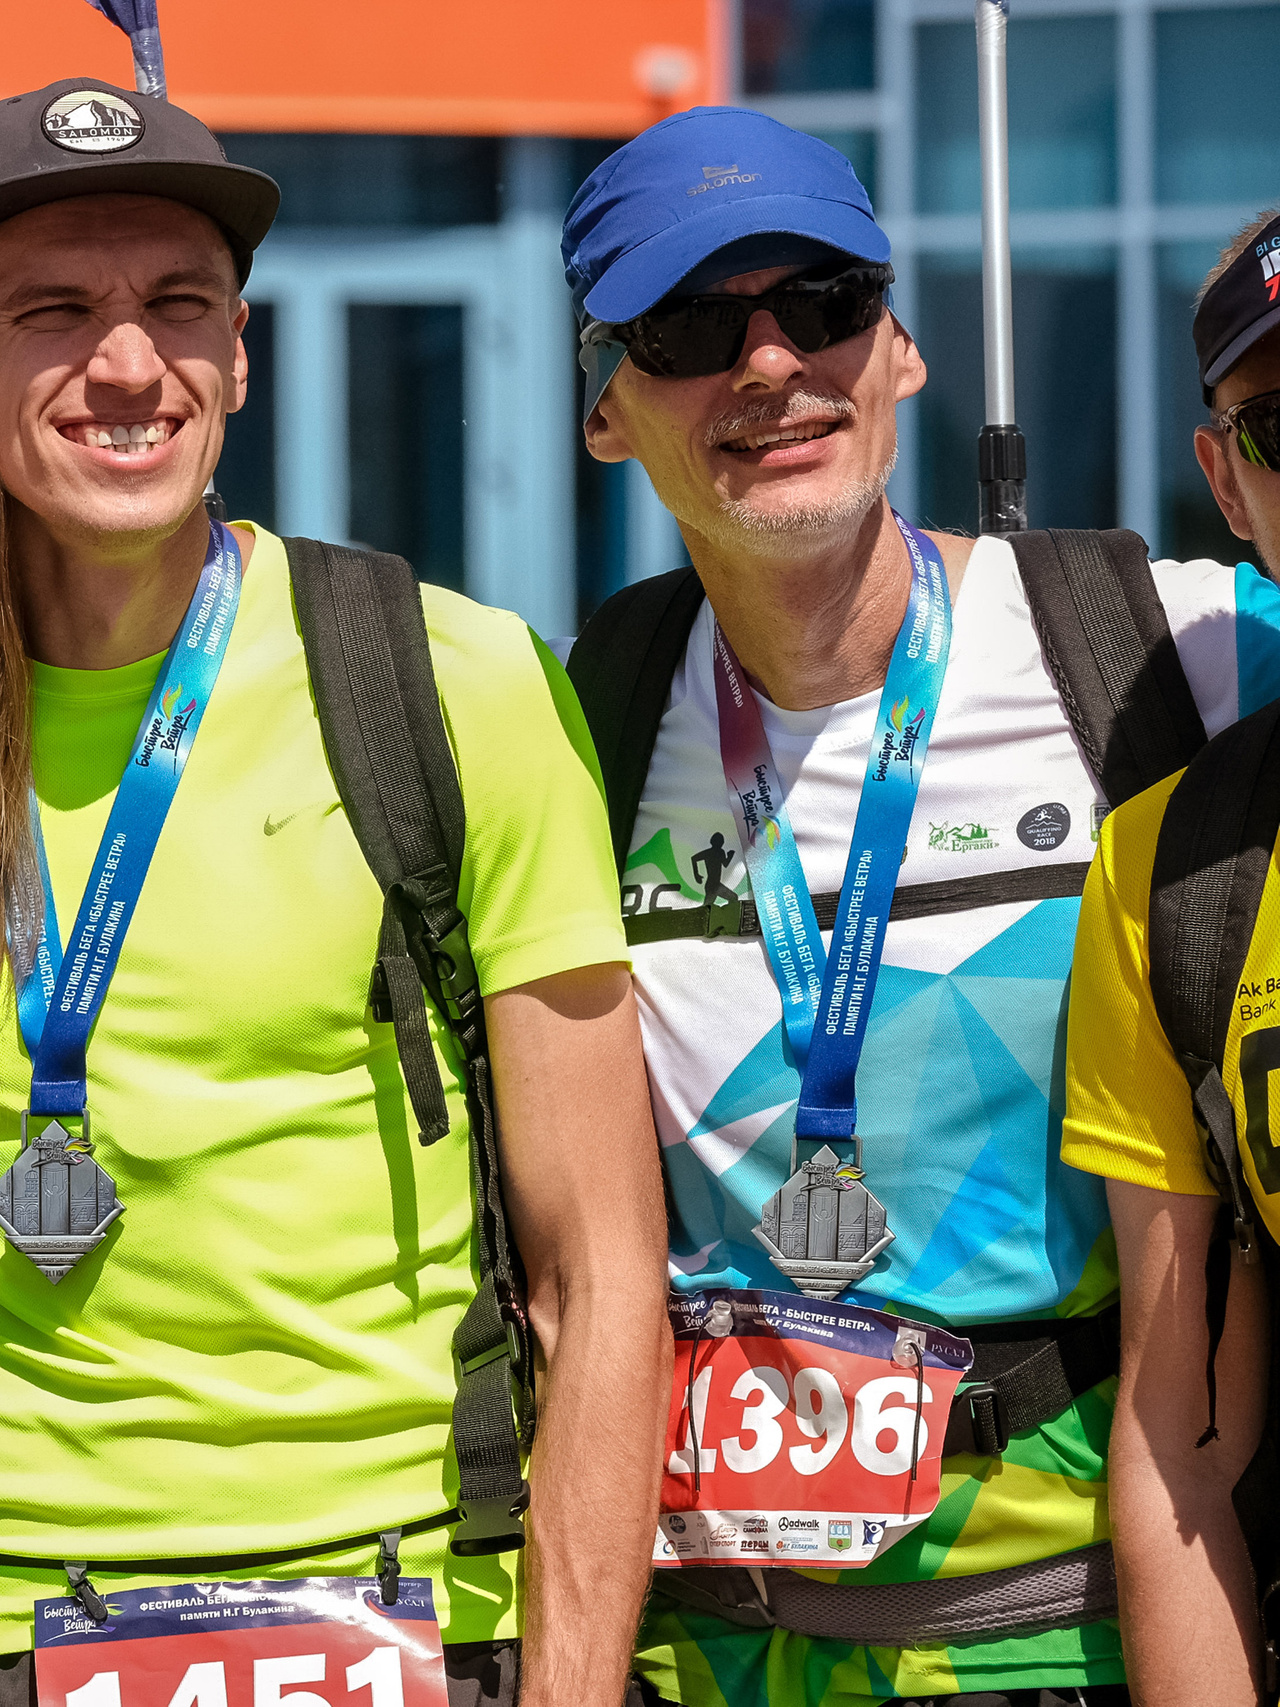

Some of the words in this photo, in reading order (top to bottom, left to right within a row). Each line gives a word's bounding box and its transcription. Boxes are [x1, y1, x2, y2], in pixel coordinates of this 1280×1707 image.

[58, 127, 133, 139] SALOMON
[686, 173, 762, 198] salomon
[1256, 241, 1269, 257] BI
[186, 591, 216, 649] ФЕСТИВАЛЬ
[208, 564, 223, 591] БЕГА
[906, 600, 929, 659] ФЕСТИВАЛЬ
[919, 576, 930, 602] БЕГА
[204, 614, 227, 656] ПАМЯТИ
[925, 625, 943, 664] ПАМЯТИ
[1033, 837, 1056, 846] 2018
[854, 850, 873, 887] ВЕТРА»
[60, 952, 89, 1012] ФЕСТИВАЛЬ
[79, 924, 97, 951] БЕГА
[89, 870, 116, 924] «БЫСТРЕЕ
[105, 833, 127, 871] ВЕТРА»
[763, 890, 784, 935] ПАМЯТИ
[845, 889, 865, 943] «БЫСТРЕЕ
[782, 884, 807, 945] ФЕСТИВАЛЬ
[797, 944, 816, 973] БЕГА
[838, 944, 854, 971] БЕГА
[76, 970, 102, 1015] ПАМЯТИ
[826, 972, 849, 1035] ФЕСТИВАЛЬ
[1237, 982, 1263, 999] Ak
[843, 993, 864, 1036] ПАМЯТИ
[1239, 999, 1276, 1021] Bank
[759, 1304, 780, 1316] БЕГА
[782, 1308, 836, 1326] «БЫСТРЕЕ
[838, 1317, 876, 1333] ВЕТРА»
[782, 1319, 835, 1340] Булакина
[930, 1343, 966, 1359] РУСАЛ
[668, 1365, 934, 1477] 1396
[740, 1540, 770, 1549] перцы
[43, 1604, 87, 1620] Быстре
[139, 1596, 204, 1612] ФЕСТИВАЛЬ
[180, 1609, 221, 1621] памяти
[242, 1603, 296, 1618] Булакина
